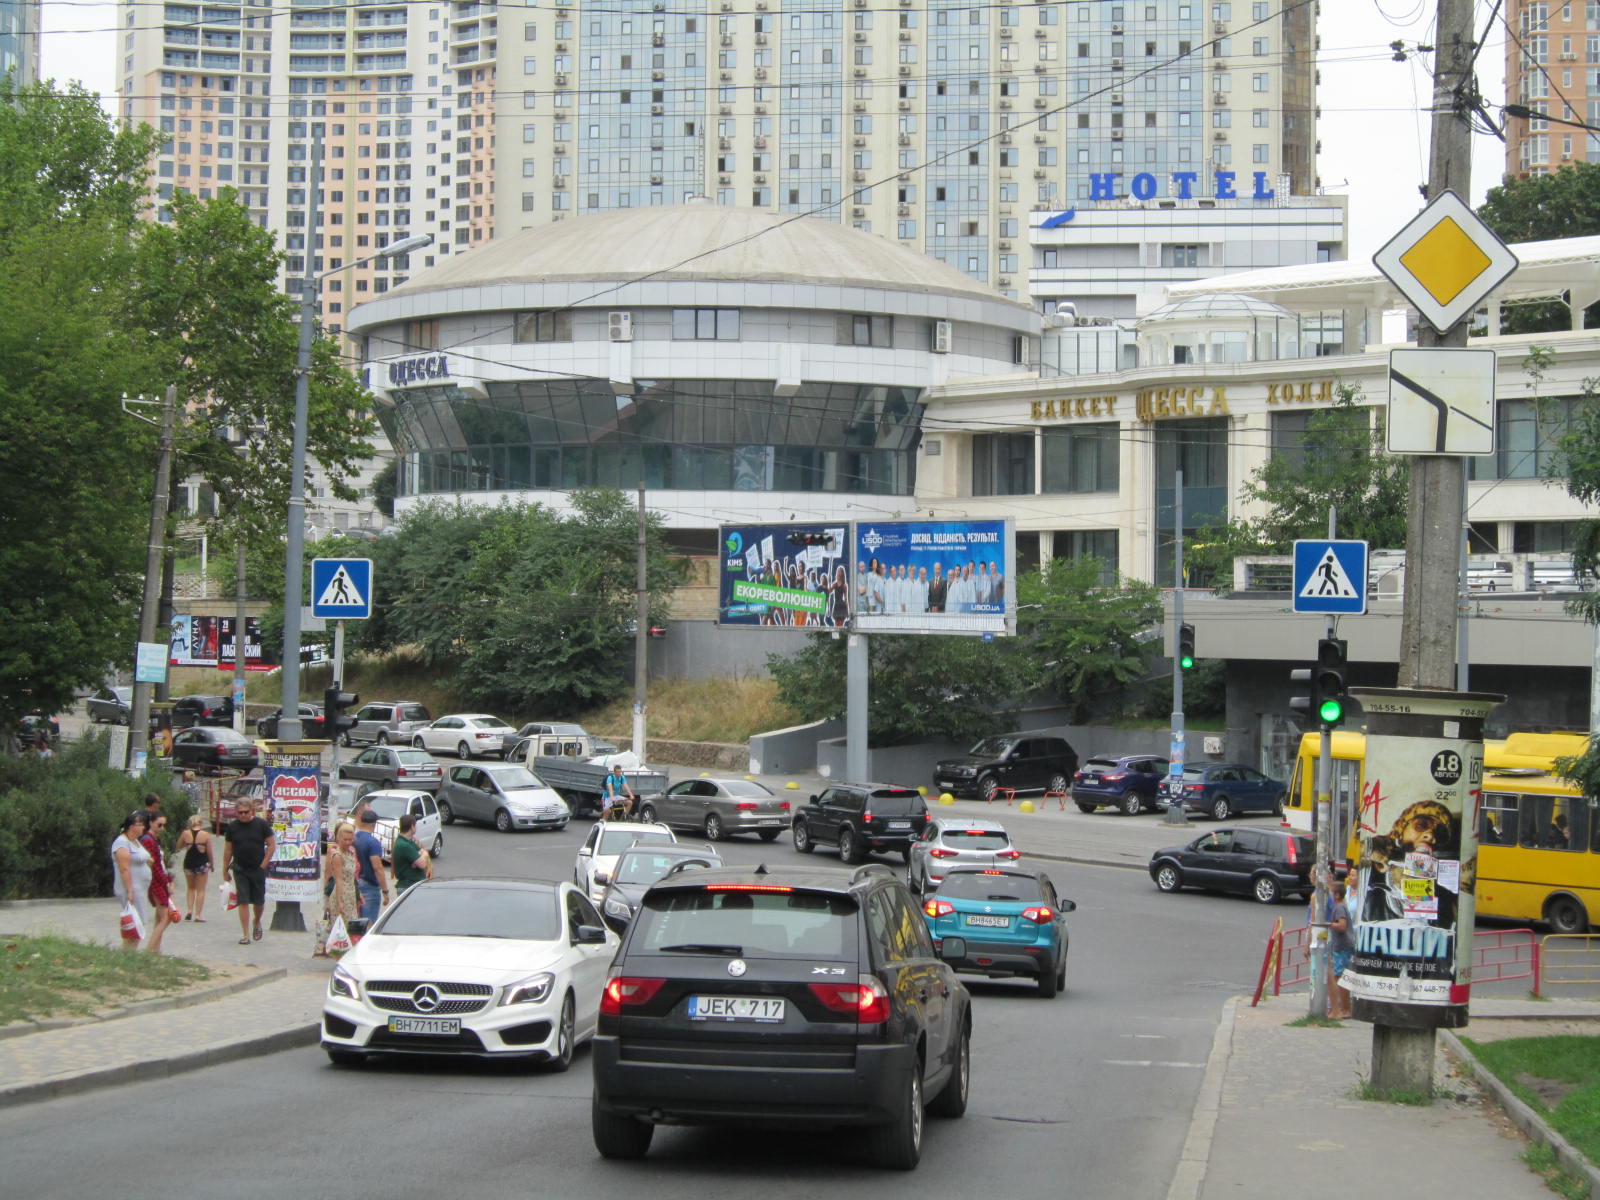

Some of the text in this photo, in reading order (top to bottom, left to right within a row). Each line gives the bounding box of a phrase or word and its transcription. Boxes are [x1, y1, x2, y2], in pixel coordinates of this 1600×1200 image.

[1089, 171, 1275, 200] HOTEL
[389, 355, 449, 386] ОДЕССА
[1030, 395, 1117, 419] БАНКЕТ
[1266, 380, 1333, 403] ХОЛЛ
[911, 533, 932, 544] ДОСВІД.
[967, 532, 999, 543] РЕЗУЛЬТАТ.
[736, 584, 823, 609] ЕКОРЕВОЛЮШН!
[1437, 755, 1459, 772] 18
[699, 998, 782, 1017] JEK 717
